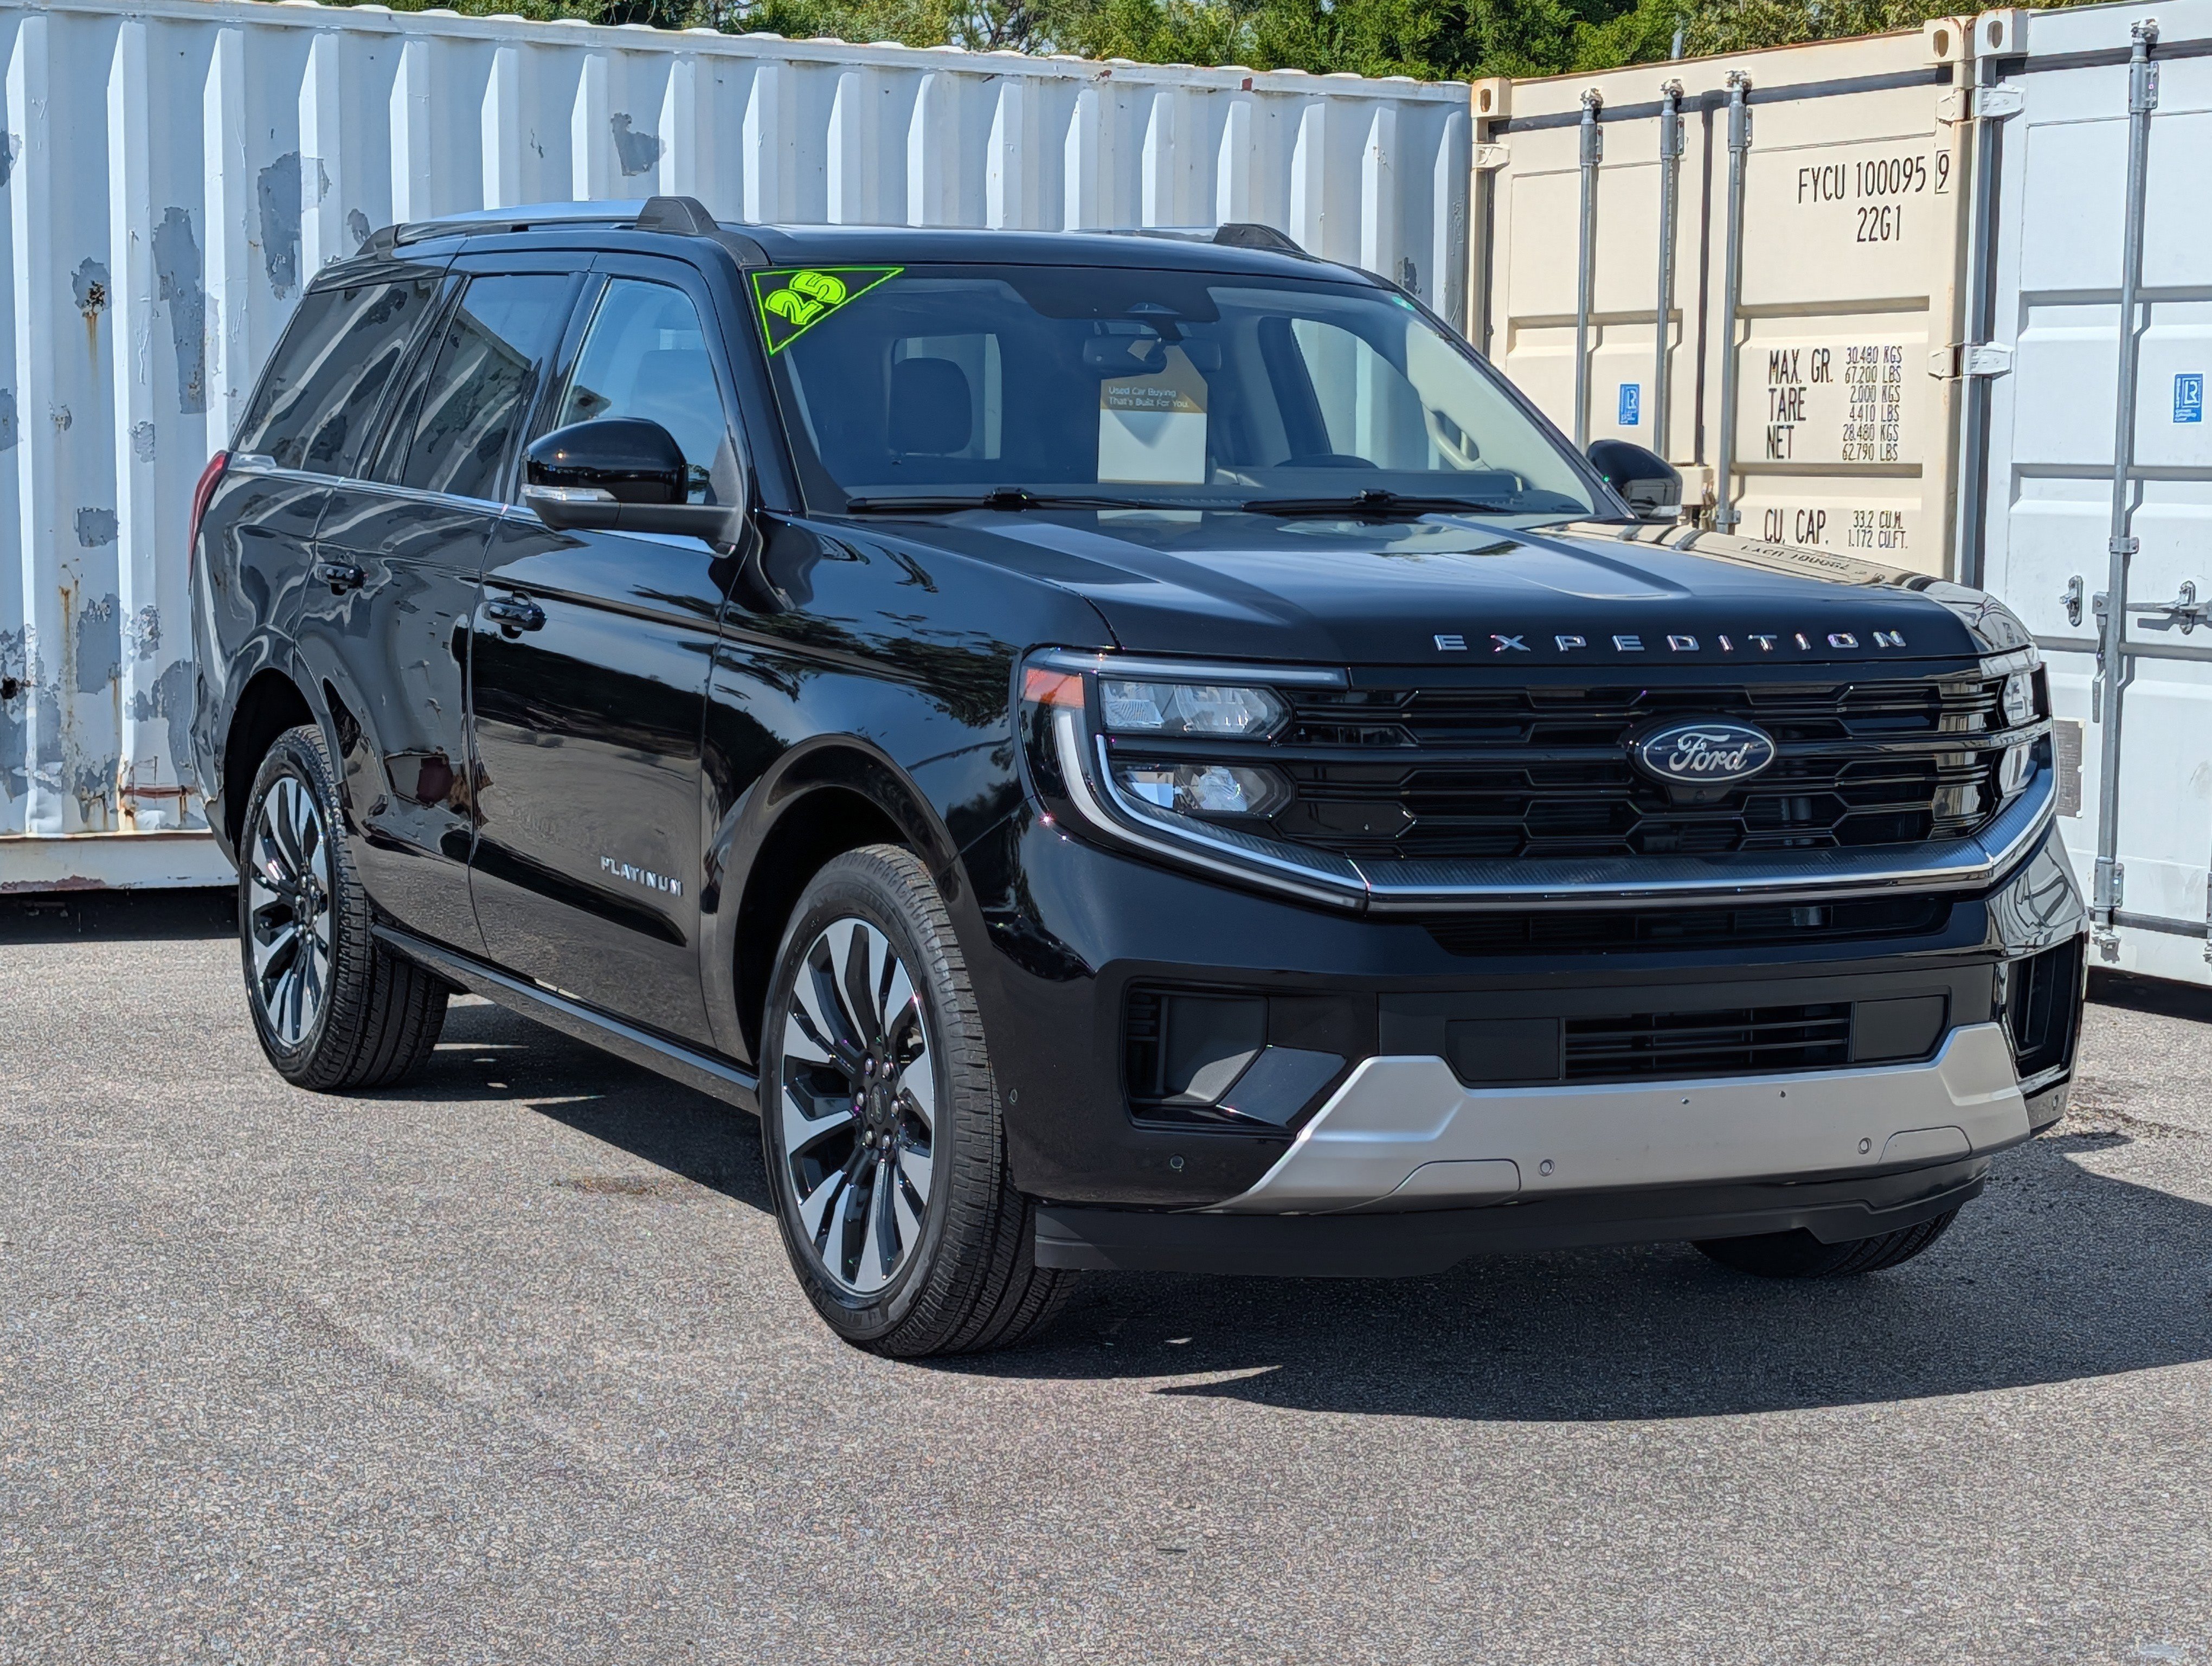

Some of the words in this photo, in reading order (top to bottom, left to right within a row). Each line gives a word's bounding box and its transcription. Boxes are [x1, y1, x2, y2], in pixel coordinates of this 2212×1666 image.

[1798, 164, 1846, 204] FYCU
[1856, 156, 1927, 198] 100095
[1938, 153, 1950, 190] 9
[1856, 204, 1901, 242] 22G1
[764, 271, 846, 325] 25
[1769, 349, 1803, 385] MAX.
[1811, 348, 1834, 383] GR.
[1883, 345, 1902, 363] KGS
[1882, 364, 1901, 383] LBS
[1108, 386, 1130, 395] Used
[1132, 387, 1146, 395] Car
[1148, 388, 1176, 397] Buying
[1768, 387, 1807, 422] TARE
[1882, 385, 1901, 402] KGS
[1881, 404, 1900, 422] LBS
[1766, 425, 1795, 460] NET
[1880, 424, 1900, 441] KGS
[1880, 443, 1898, 461] LBS
[1764, 509, 1786, 544] CU.
[1796, 509, 1829, 544] CAP.
[1433, 630, 1907, 653] EXPEDITION
[1668, 732, 1749, 772] Ford
[600, 855, 683, 897] PLATINUM
